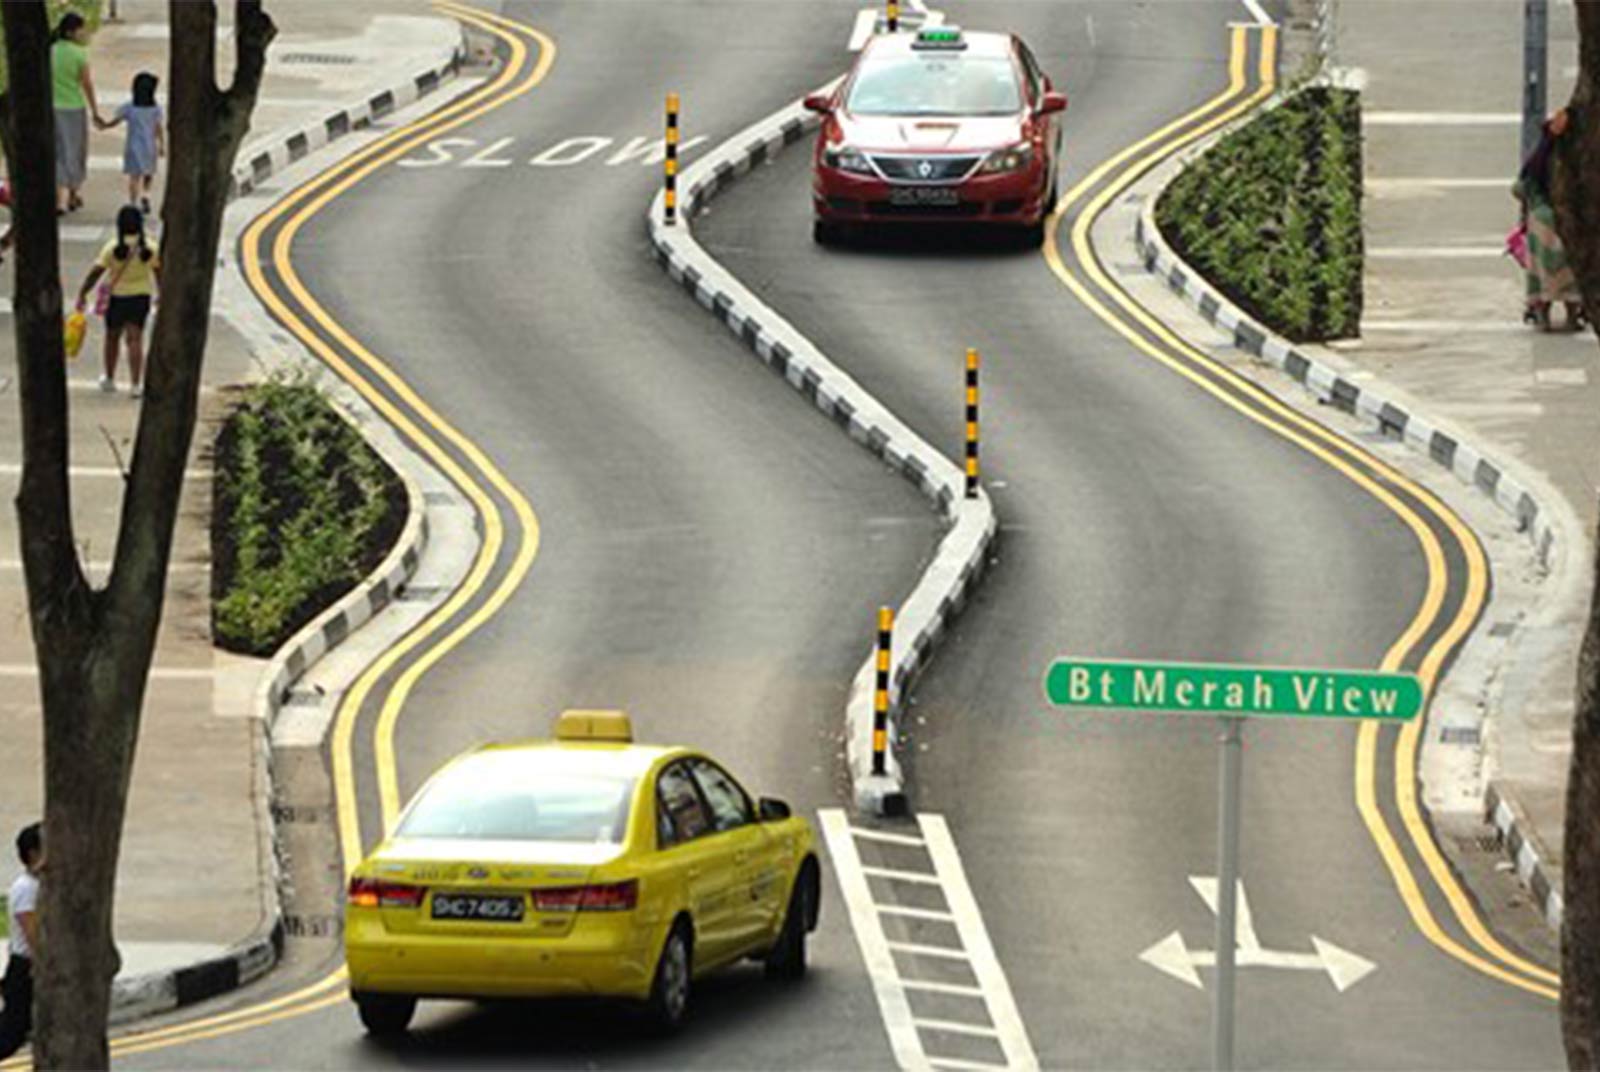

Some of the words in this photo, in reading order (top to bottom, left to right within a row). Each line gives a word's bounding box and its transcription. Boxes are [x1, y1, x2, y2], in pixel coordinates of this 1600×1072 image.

[397, 136, 708, 166] SLOW
[1069, 668, 1114, 702] Bt
[1133, 670, 1272, 709] Merah
[1293, 676, 1398, 713] View
